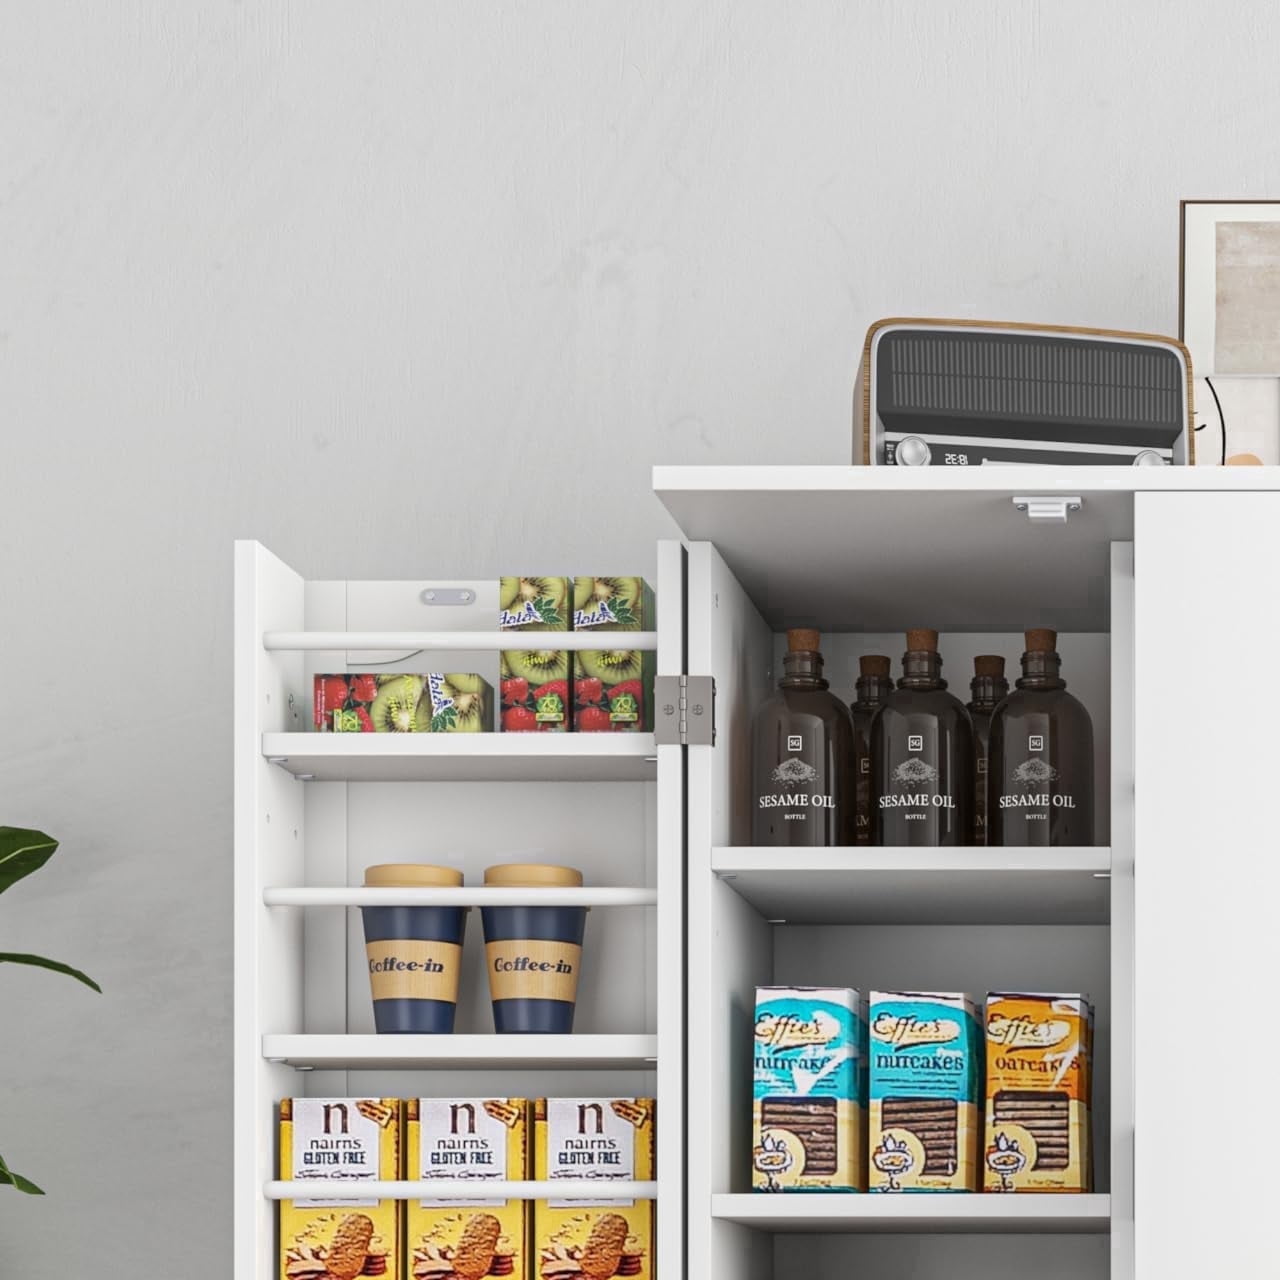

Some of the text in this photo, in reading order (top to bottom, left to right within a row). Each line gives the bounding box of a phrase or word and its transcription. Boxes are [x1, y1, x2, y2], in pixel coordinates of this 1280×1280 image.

[760, 794, 835, 808] SESAME OIL
[879, 794, 956, 808] SESAME OIL
[1000, 794, 1077, 808] SESAME OIL
[494, 957, 572, 974] Coffee-in
